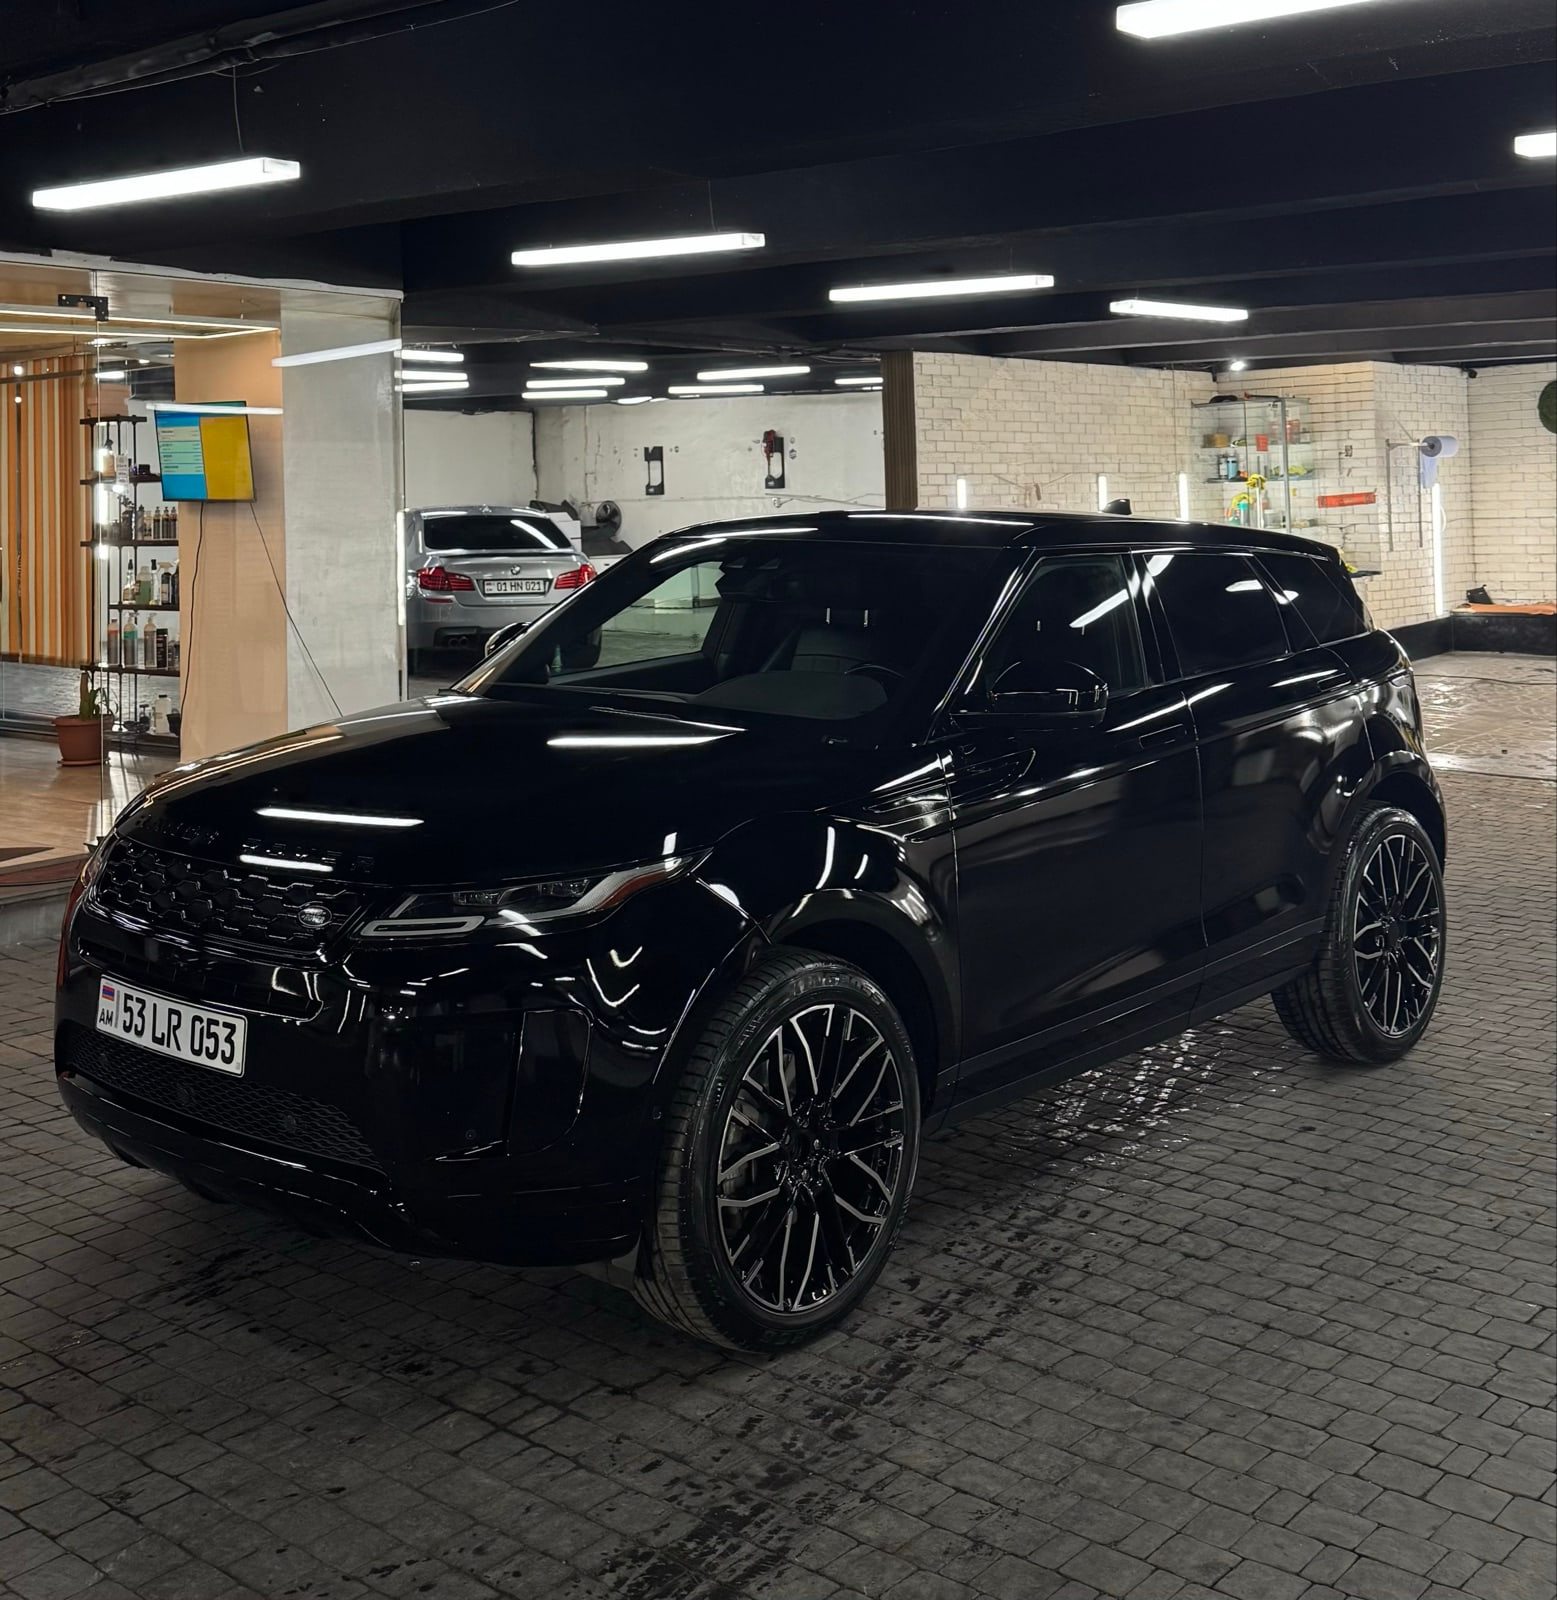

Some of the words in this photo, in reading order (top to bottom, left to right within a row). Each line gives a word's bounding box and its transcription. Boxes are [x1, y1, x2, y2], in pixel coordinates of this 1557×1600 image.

[497, 582, 508, 592] 01
[510, 582, 523, 592] HN
[525, 581, 541, 591] 021
[99, 1008, 114, 1026] AM
[122, 992, 146, 1038] 53
[151, 1002, 182, 1052] LR
[189, 1014, 237, 1065] 053
